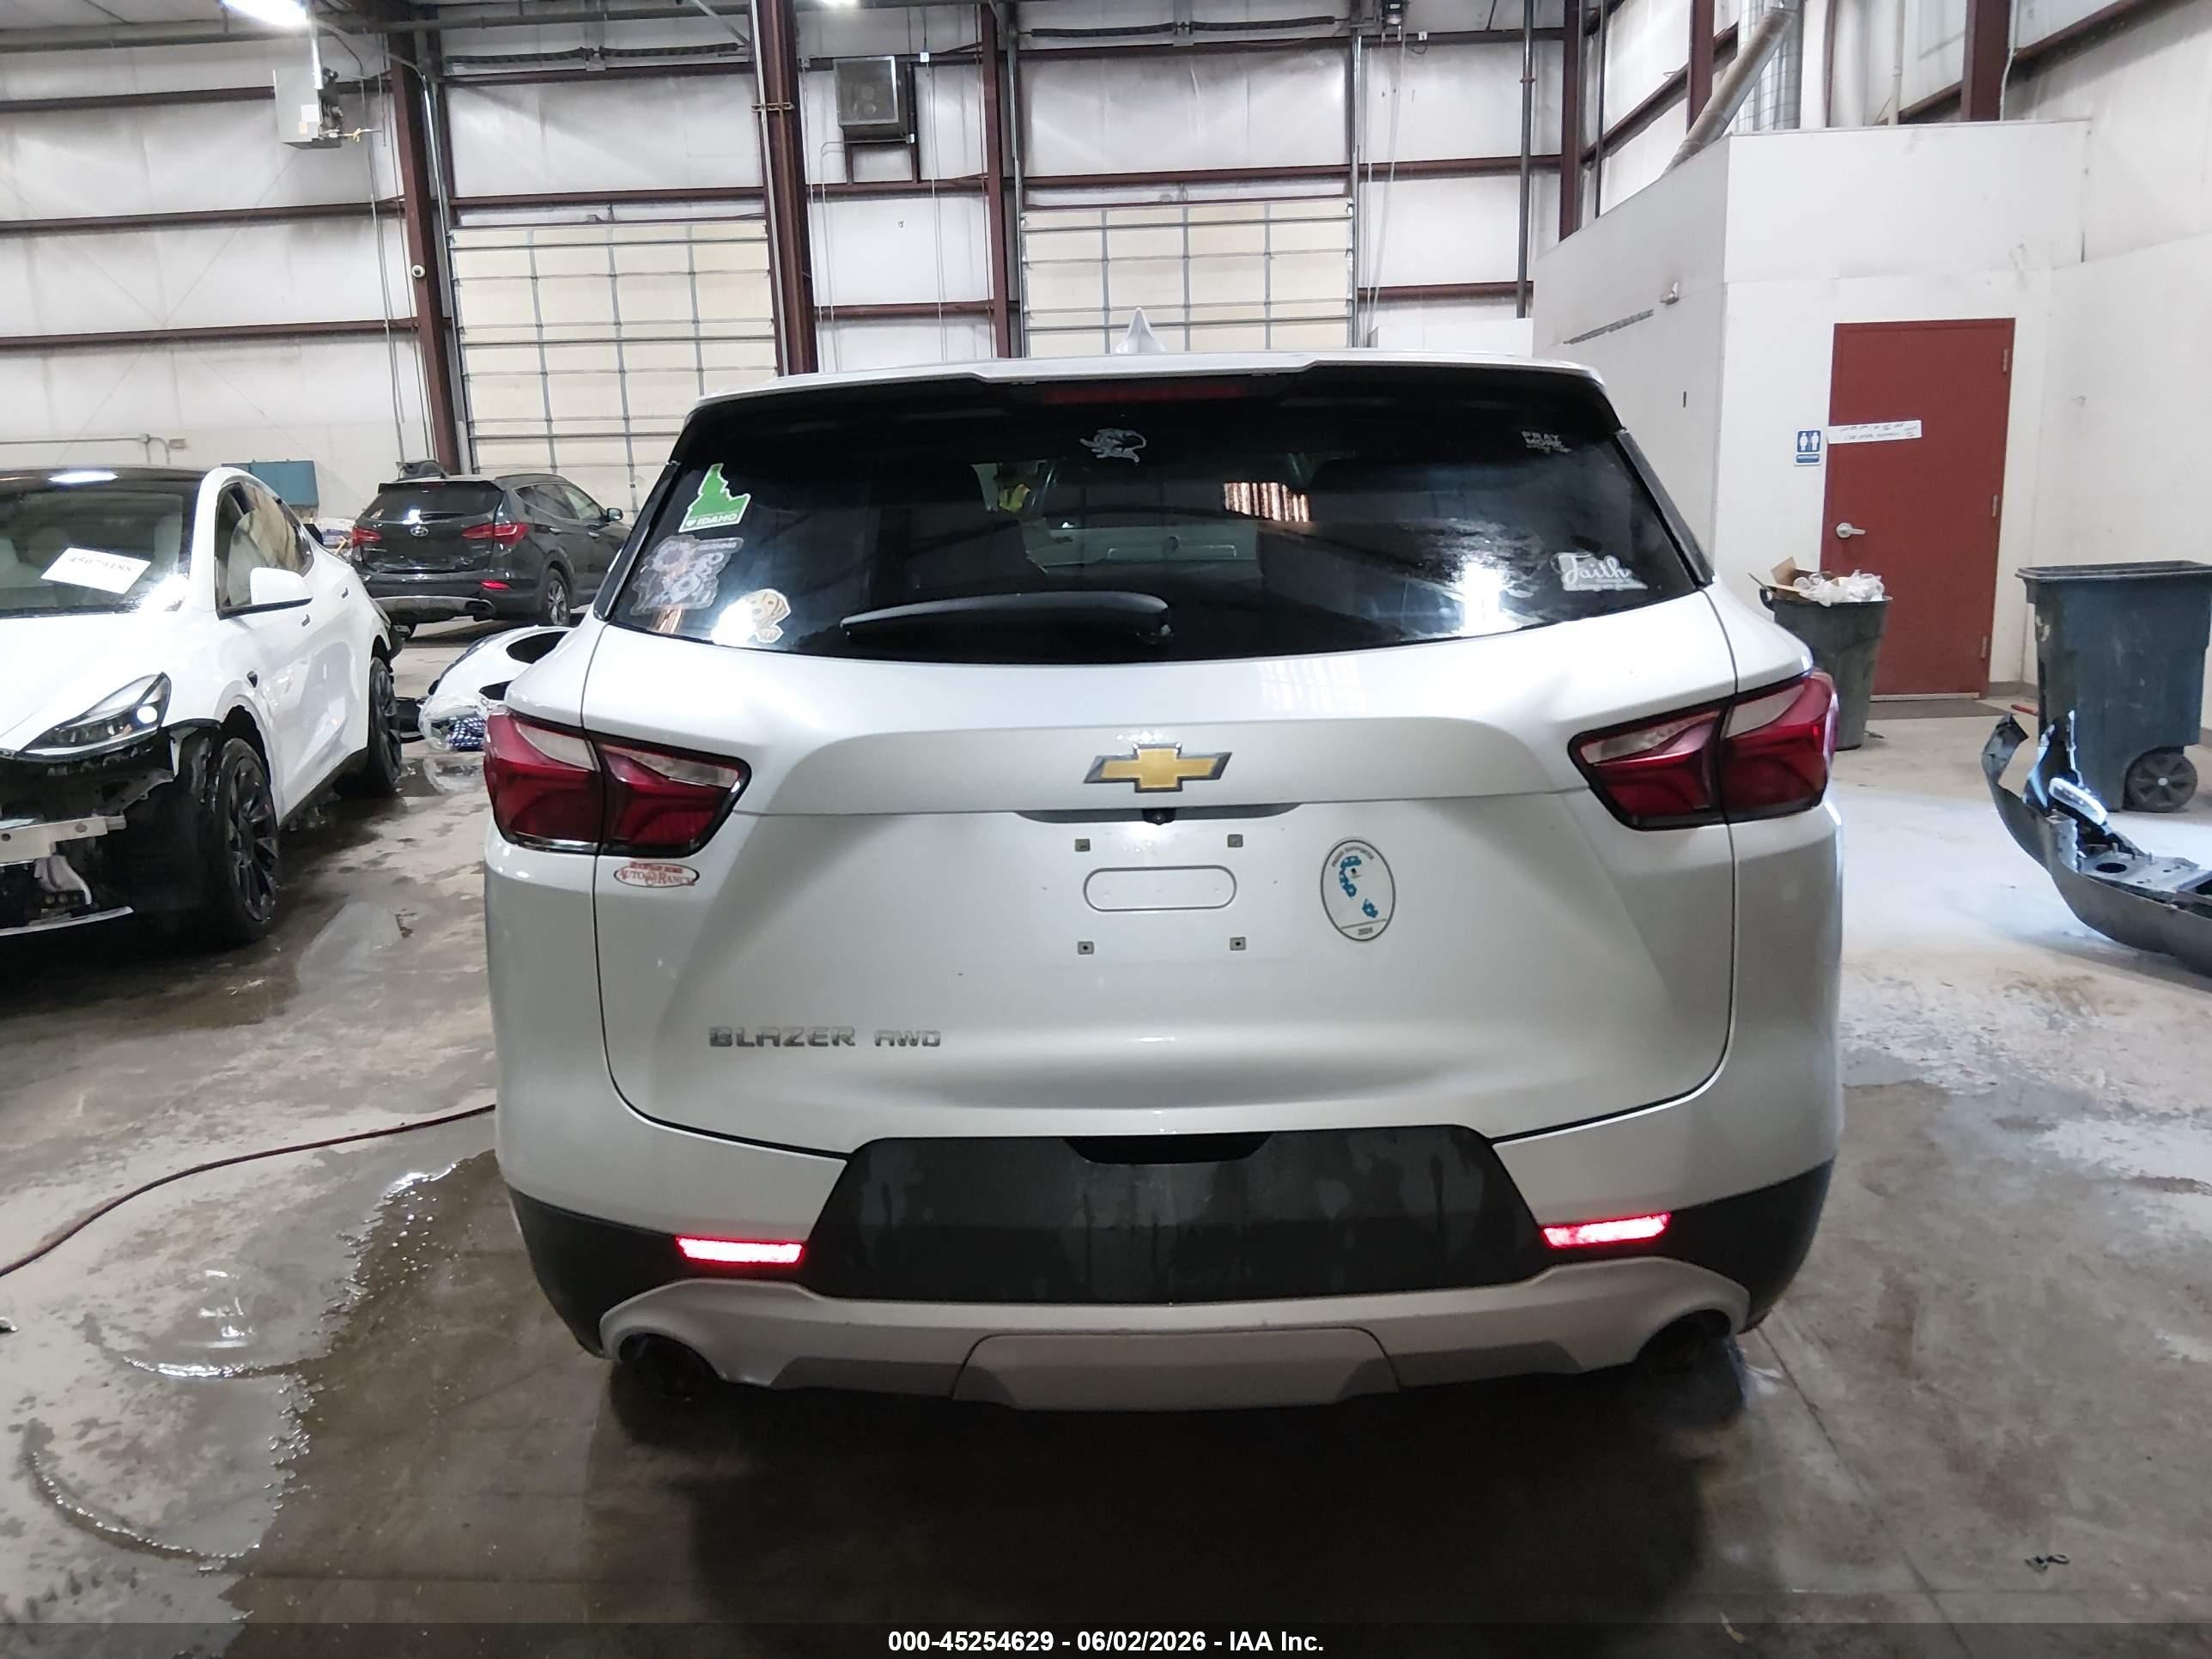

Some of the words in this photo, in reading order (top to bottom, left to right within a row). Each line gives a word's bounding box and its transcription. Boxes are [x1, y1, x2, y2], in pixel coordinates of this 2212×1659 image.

[696, 514, 738, 526] IDAHO
[1558, 552, 1632, 585] Faith
[709, 1026, 856, 1048] BLAZER
[874, 1029, 941, 1047] AWD
